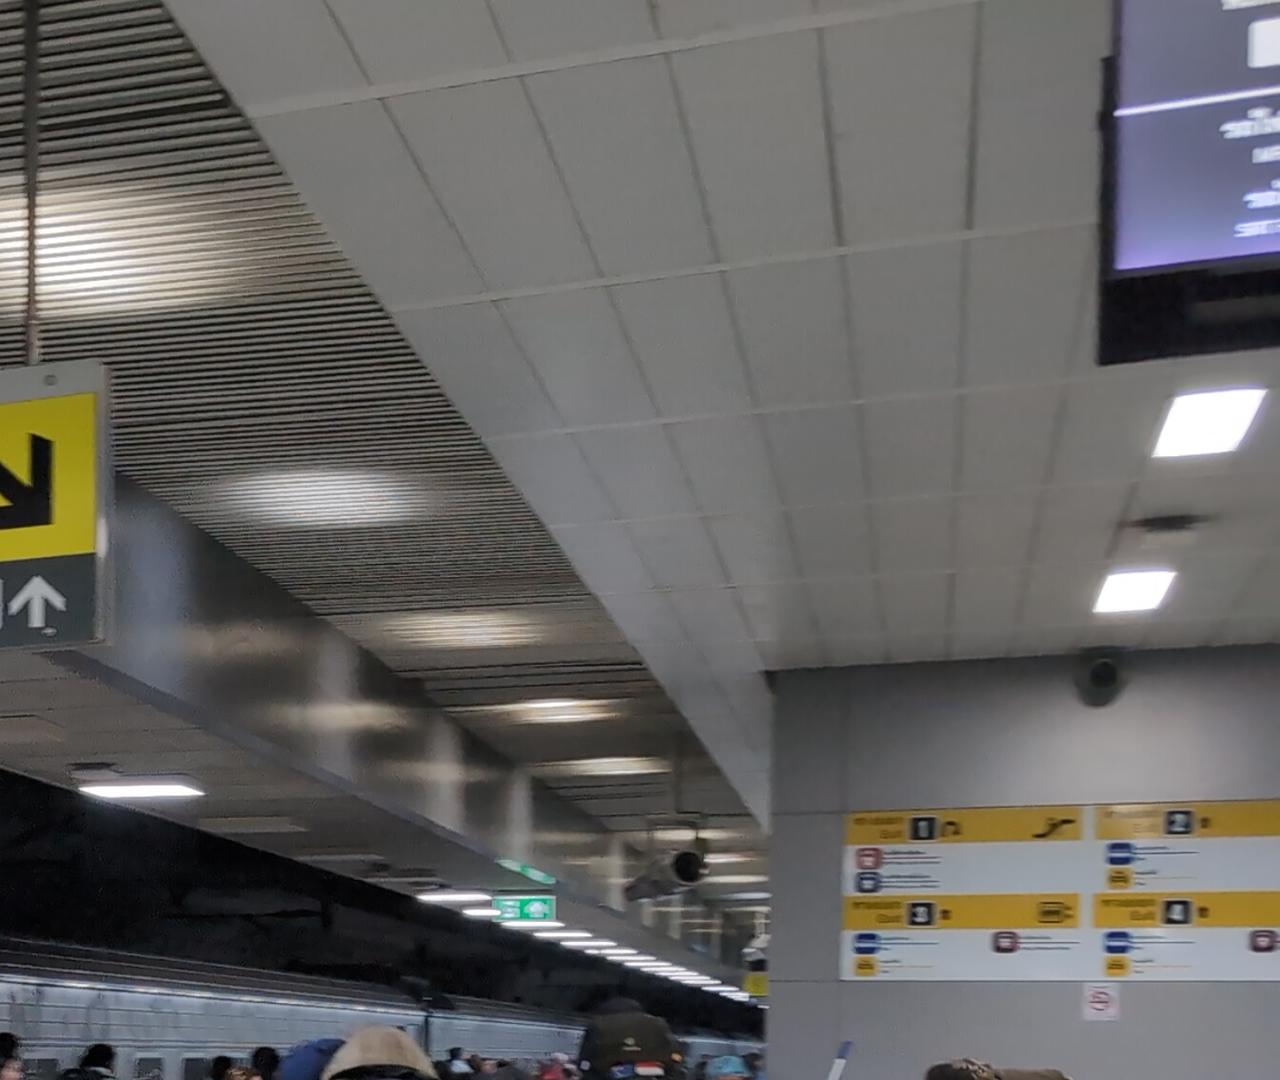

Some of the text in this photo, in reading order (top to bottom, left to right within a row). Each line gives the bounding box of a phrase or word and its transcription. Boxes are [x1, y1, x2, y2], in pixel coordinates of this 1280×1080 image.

[917, 819, 930, 838] 1
[1169, 813, 1187, 832] 2
[912, 905, 929, 923] 3
[1167, 903, 1185, 921] 4
